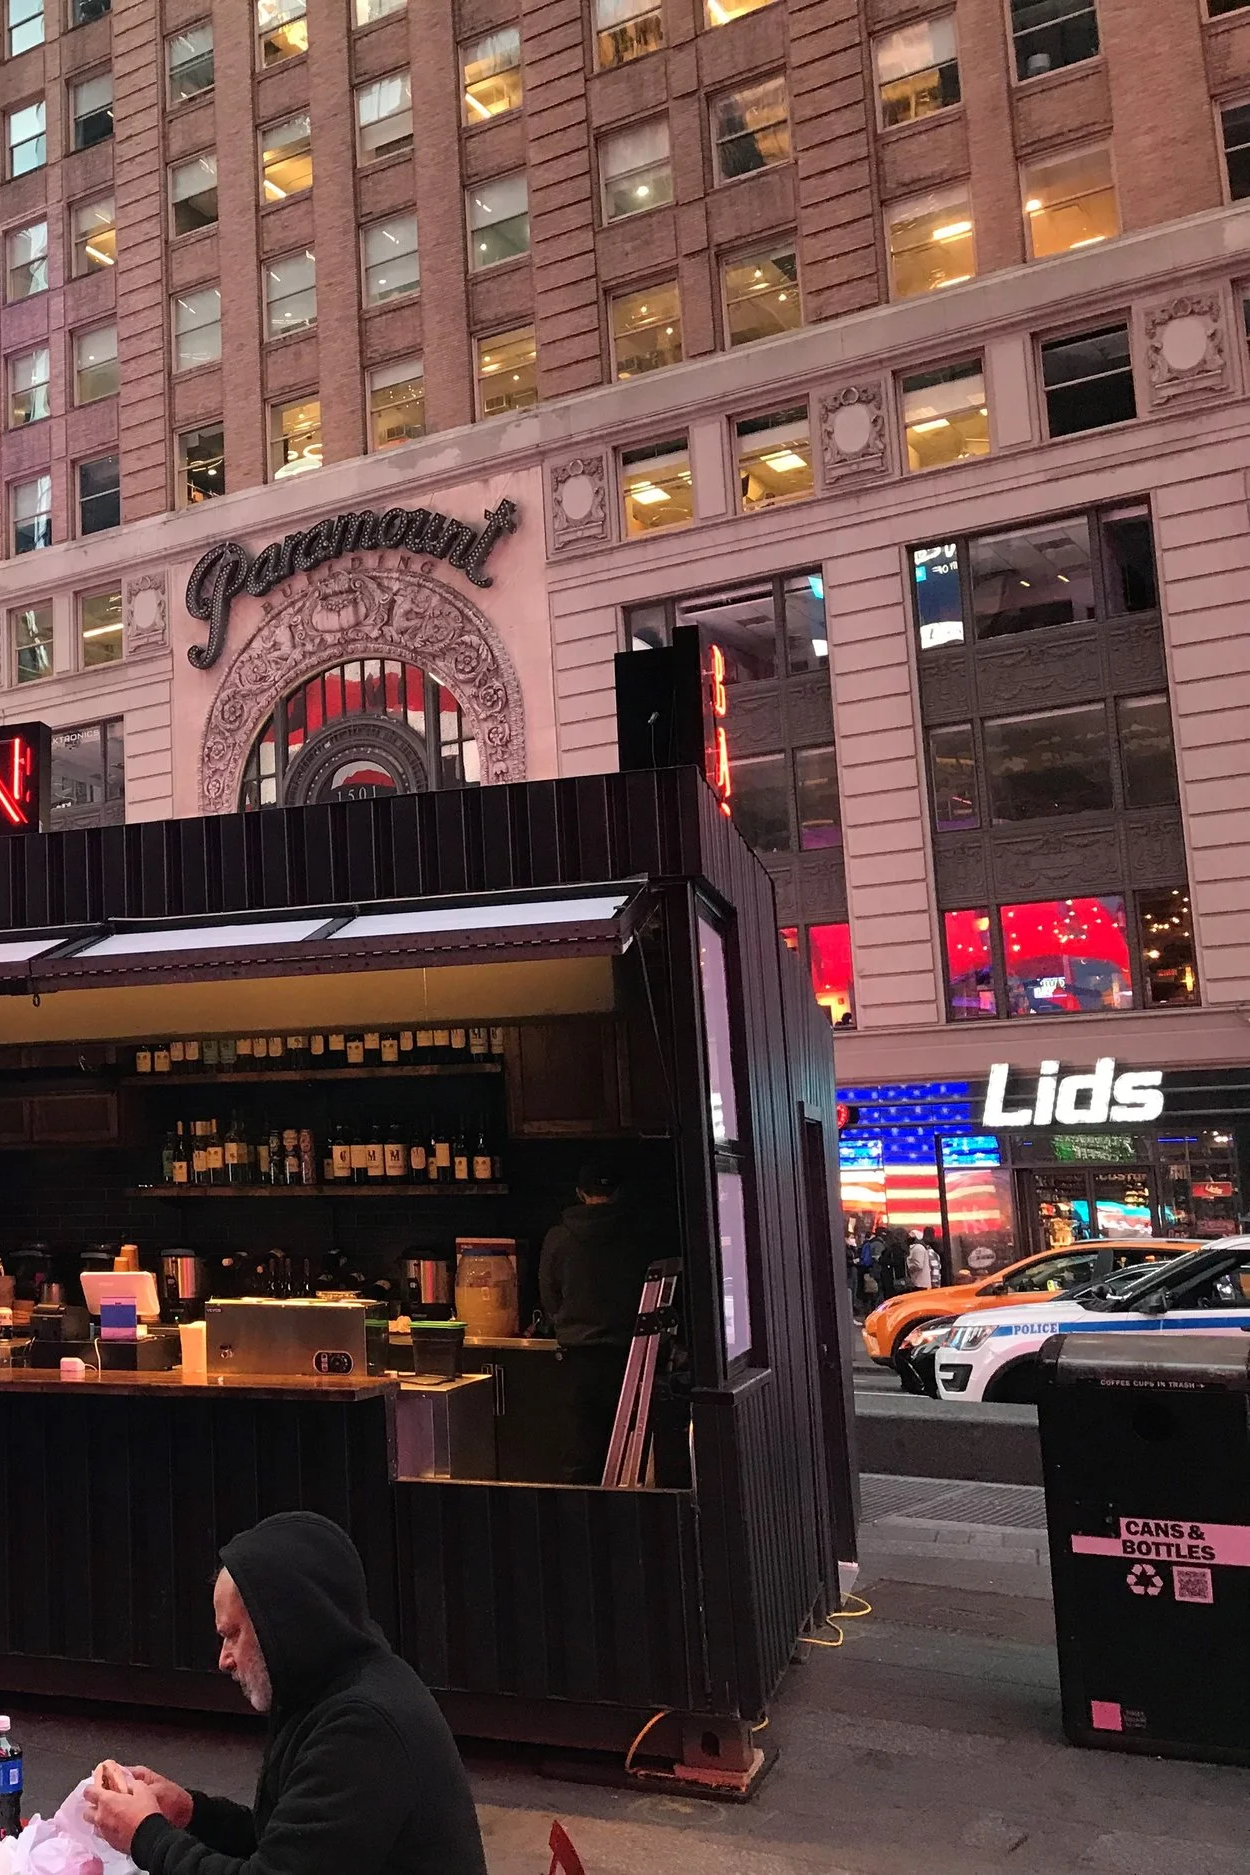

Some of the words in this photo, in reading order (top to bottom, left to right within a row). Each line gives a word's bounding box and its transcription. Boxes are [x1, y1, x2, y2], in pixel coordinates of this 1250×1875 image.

[186, 497, 519, 670] Paramount
[982, 1056, 1165, 1128] Lids
[1013, 1323, 1058, 1335] POLICE
[1100, 1379, 1131, 1387] COFFEE
[1168, 1381, 1195, 1389] TRASH
[1125, 1520, 1185, 1541] CANS
[1188, 1523, 1206, 1542] &
[1122, 1539, 1216, 1561] BOTTLES
